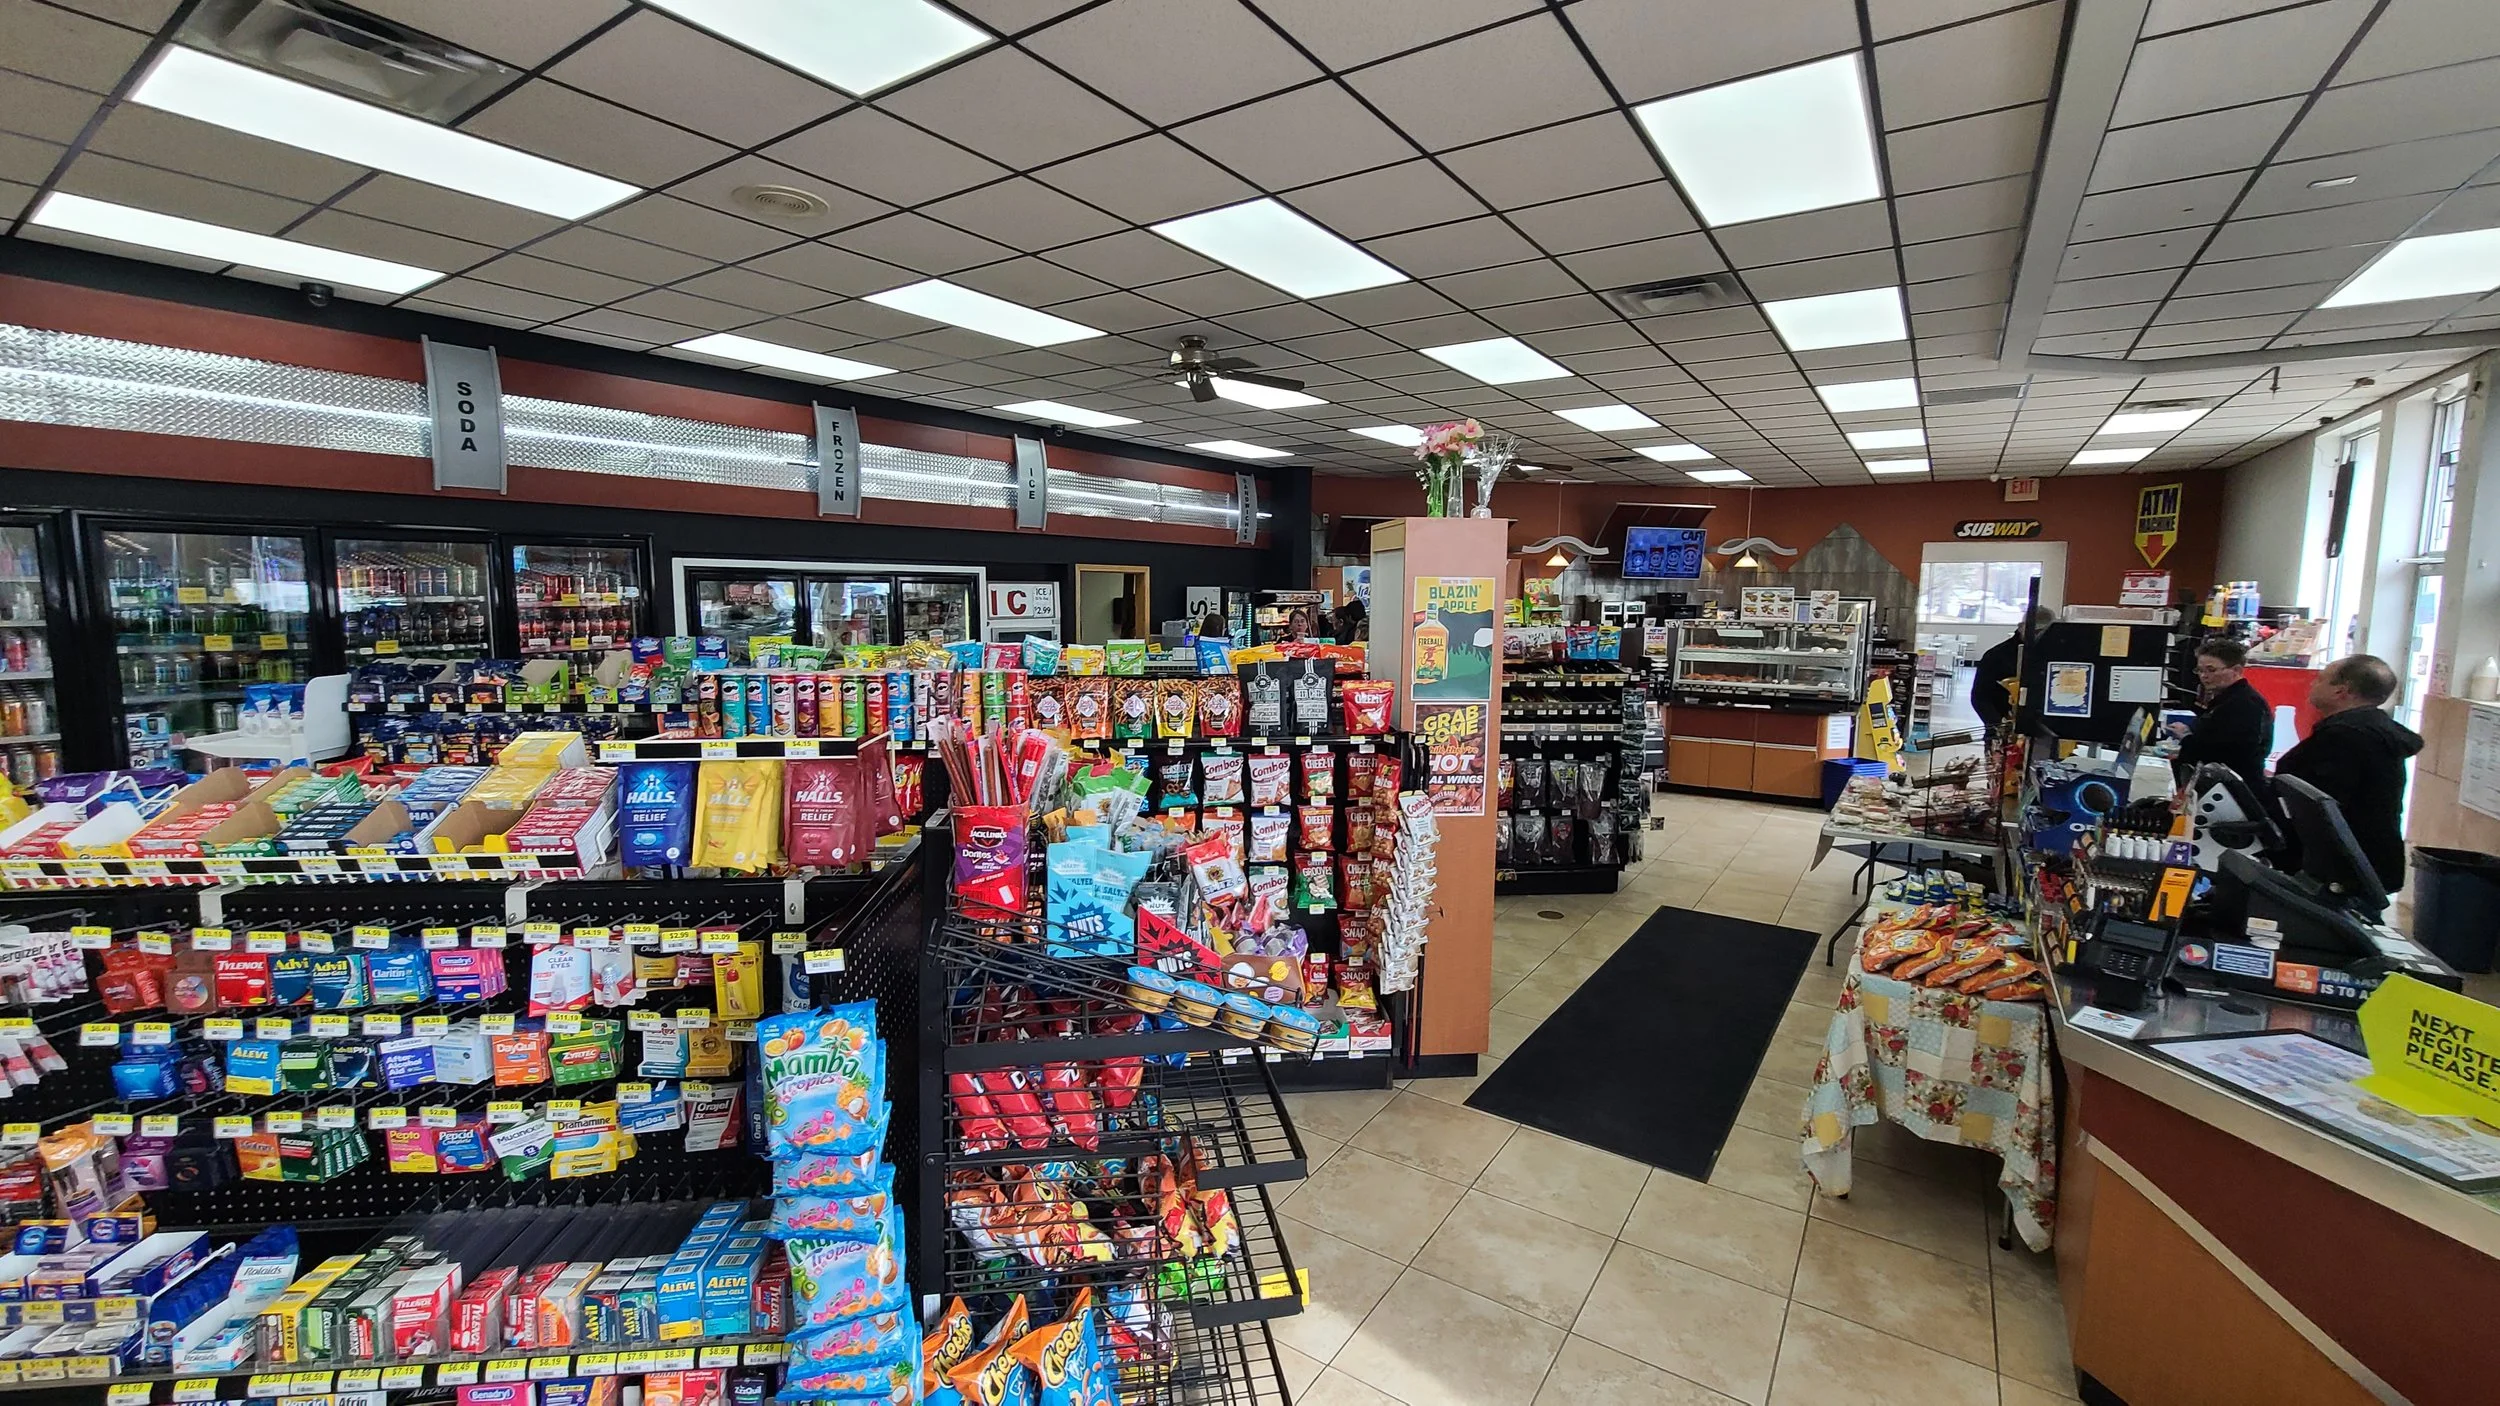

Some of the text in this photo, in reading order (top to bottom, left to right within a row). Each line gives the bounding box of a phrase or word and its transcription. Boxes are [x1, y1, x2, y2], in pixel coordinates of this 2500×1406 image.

[456, 381, 478, 452] SODA
[831, 421, 845, 502] FROZEN
[1027, 467, 1036, 500] ICE
[2012, 480, 2034, 494] EXIT
[2143, 488, 2178, 516] ATM
[1957, 521, 2040, 537] SUBWAY
[1429, 584, 1482, 600] BLAZIN'
[1443, 600, 1477, 611] APPLE
[1418, 637, 1444, 647] FIREBALL
[1423, 705, 1479, 731] GRAB
[1425, 720, 1478, 746] SOME
[1203, 759, 1240, 775] Combos
[1252, 760, 1289, 777] Combos
[1429, 754, 1476, 772] HOT
[1447, 775, 1484, 784] WINGS
[633, 813, 667, 822] RELIEF
[801, 813, 834, 822] RELIEF
[962, 849, 992, 859] Doritos
[1302, 867, 1333, 876] GROOVES
[1252, 876, 1287, 894] Combos
[1067, 914, 1105, 939] NUTS
[218, 960, 264, 970] TYLENOL
[314, 960, 347, 971] Advil
[440, 957, 472, 966] Benadryl
[548, 956, 574, 964] CLEAR
[372, 969, 405, 978] Claritin
[2322, 969, 2350, 983] OUR
[2320, 983, 2355, 998] IS TO
[2411, 1008, 2475, 1044] NEXT
[232, 1047, 269, 1059] ALEVE
[497, 1042, 537, 1054] DayQuil
[562, 1049, 597, 1060] ZYRTEC
[387, 1059, 422, 1069] Alcohol
[764, 1047, 860, 1090] Mamba
[2406, 1041, 2497, 1092] PLEASE.
[389, 1068, 405, 1076] Aid
[776, 1075, 835, 1095] Tropics
[697, 1100, 729, 1112] Orajel
[557, 1116, 611, 1131] Dramamine
[390, 1131, 420, 1140] Pepto
[438, 1129, 474, 1140] Pepcid
[497, 1125, 536, 1143] Mucinex
[244, 1265, 282, 1276] Rolaids
[660, 1281, 696, 1294] ALEVE
[707, 1276, 748, 1288] ALEVE
[770, 1285, 781, 1328] TYLENOL
[471, 1303, 483, 1345] TYLENOL
[585, 1305, 599, 1341] Advil
[623, 1307, 635, 1337] Advil
[709, 1347, 730, 1355] $8.99
[496, 1360, 518, 1369] $7.19
[539, 1358, 561, 1366] $8.19
[393, 1367, 415, 1376] $7.19
[472, 1388, 510, 1399] Benadryl
